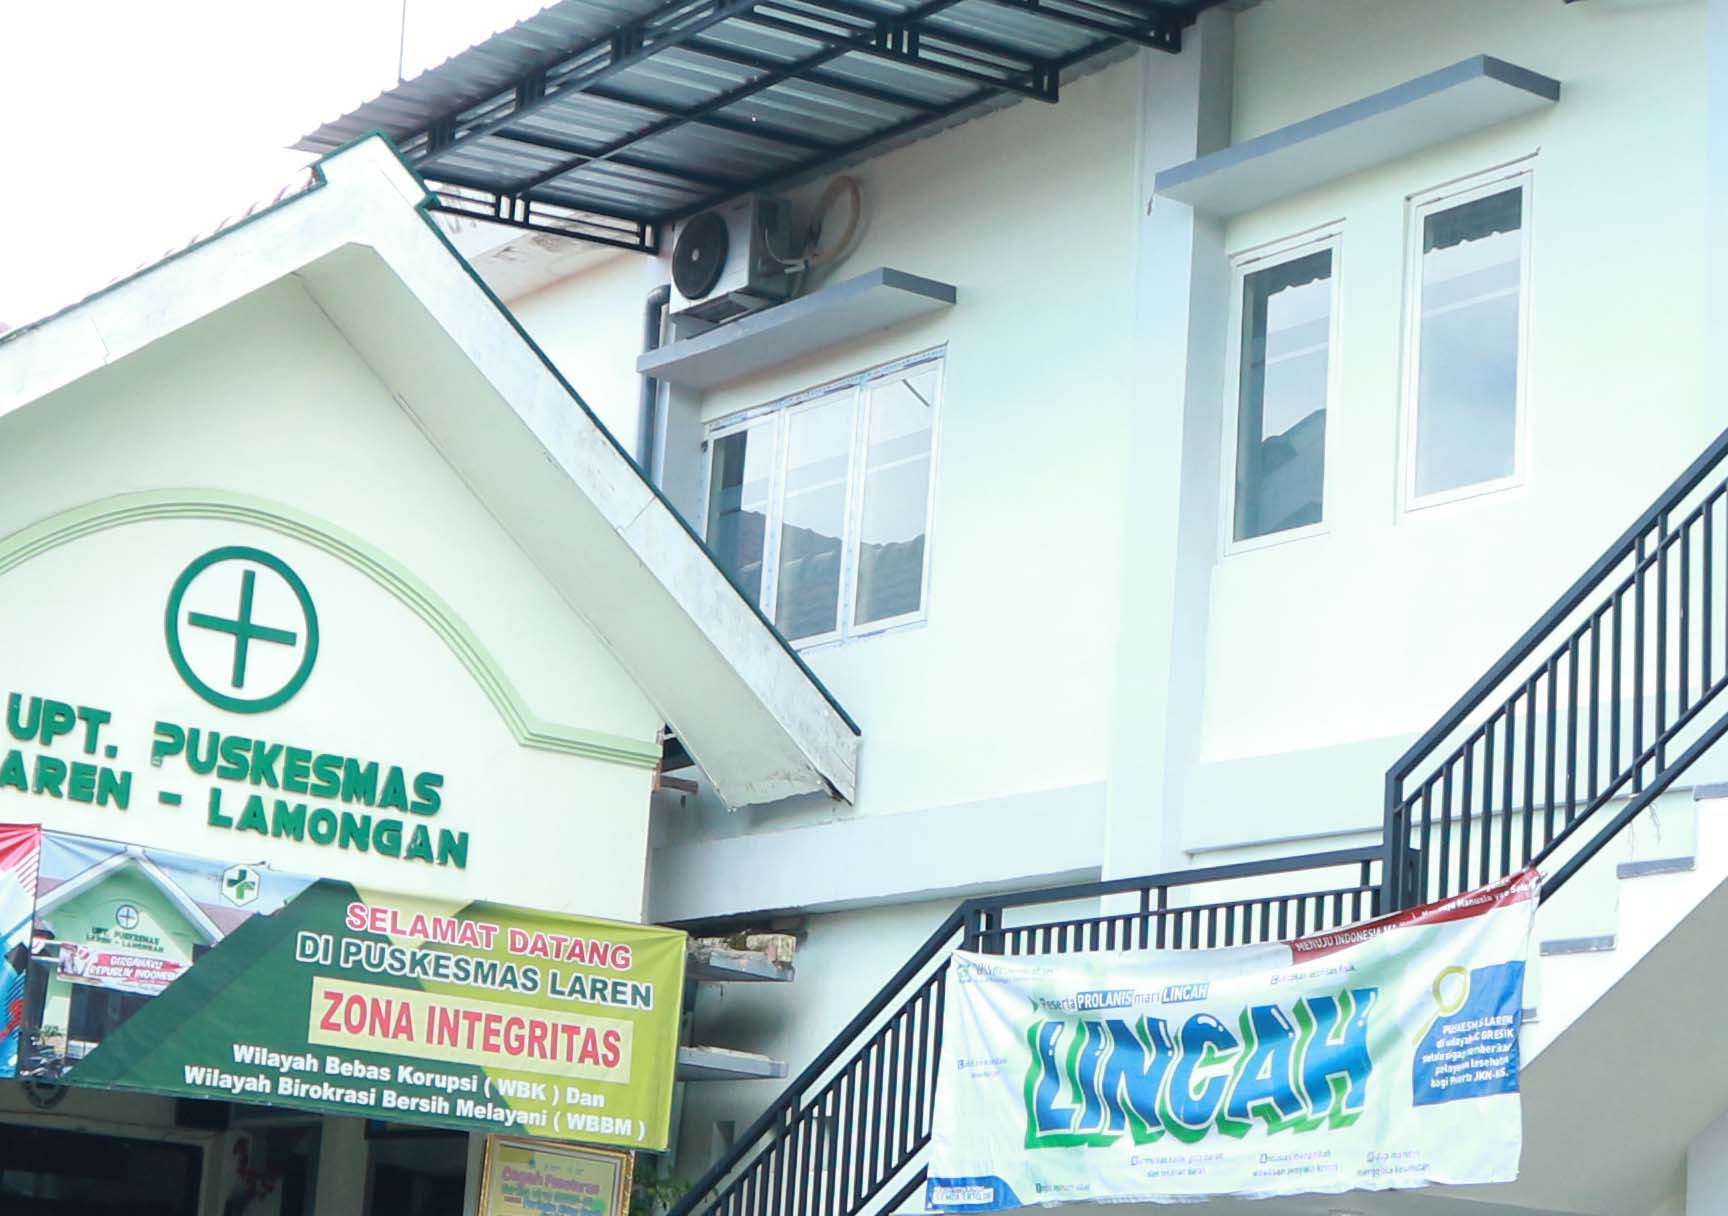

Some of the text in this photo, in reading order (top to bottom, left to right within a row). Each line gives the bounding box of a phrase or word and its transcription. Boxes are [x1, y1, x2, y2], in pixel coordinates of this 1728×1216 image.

[6, 692, 445, 817] UPT. PUSKESMAS
[207, 787, 470, 869] LAMONGAN
[296, 930, 654, 1011] DI PUSKESMAS LAREN
[345, 901, 633, 972] SELAMAT DATANG
[320, 990, 622, 1070] ZONA INTEGRITAS
[1077, 990, 1133, 1009] PROLANIS
[1163, 984, 1209, 1002] LINCAH
[183, 1064, 272, 1096] Wilayah
[277, 1079, 376, 1107] Birokrasi
[381, 1090, 450, 1116] Bersih
[455, 1099, 548, 1130] Melayani
[566, 1114, 633, 1138] WBBM
[232, 1043, 320, 1074] Wilayah
[324, 1055, 392, 1081] Bebas
[396, 1064, 479, 1096] Korupsi
[497, 1078, 548, 1102] WBK
[565, 1086, 606, 1109] Dan
[1025, 986, 1379, 1150] LINCAH
